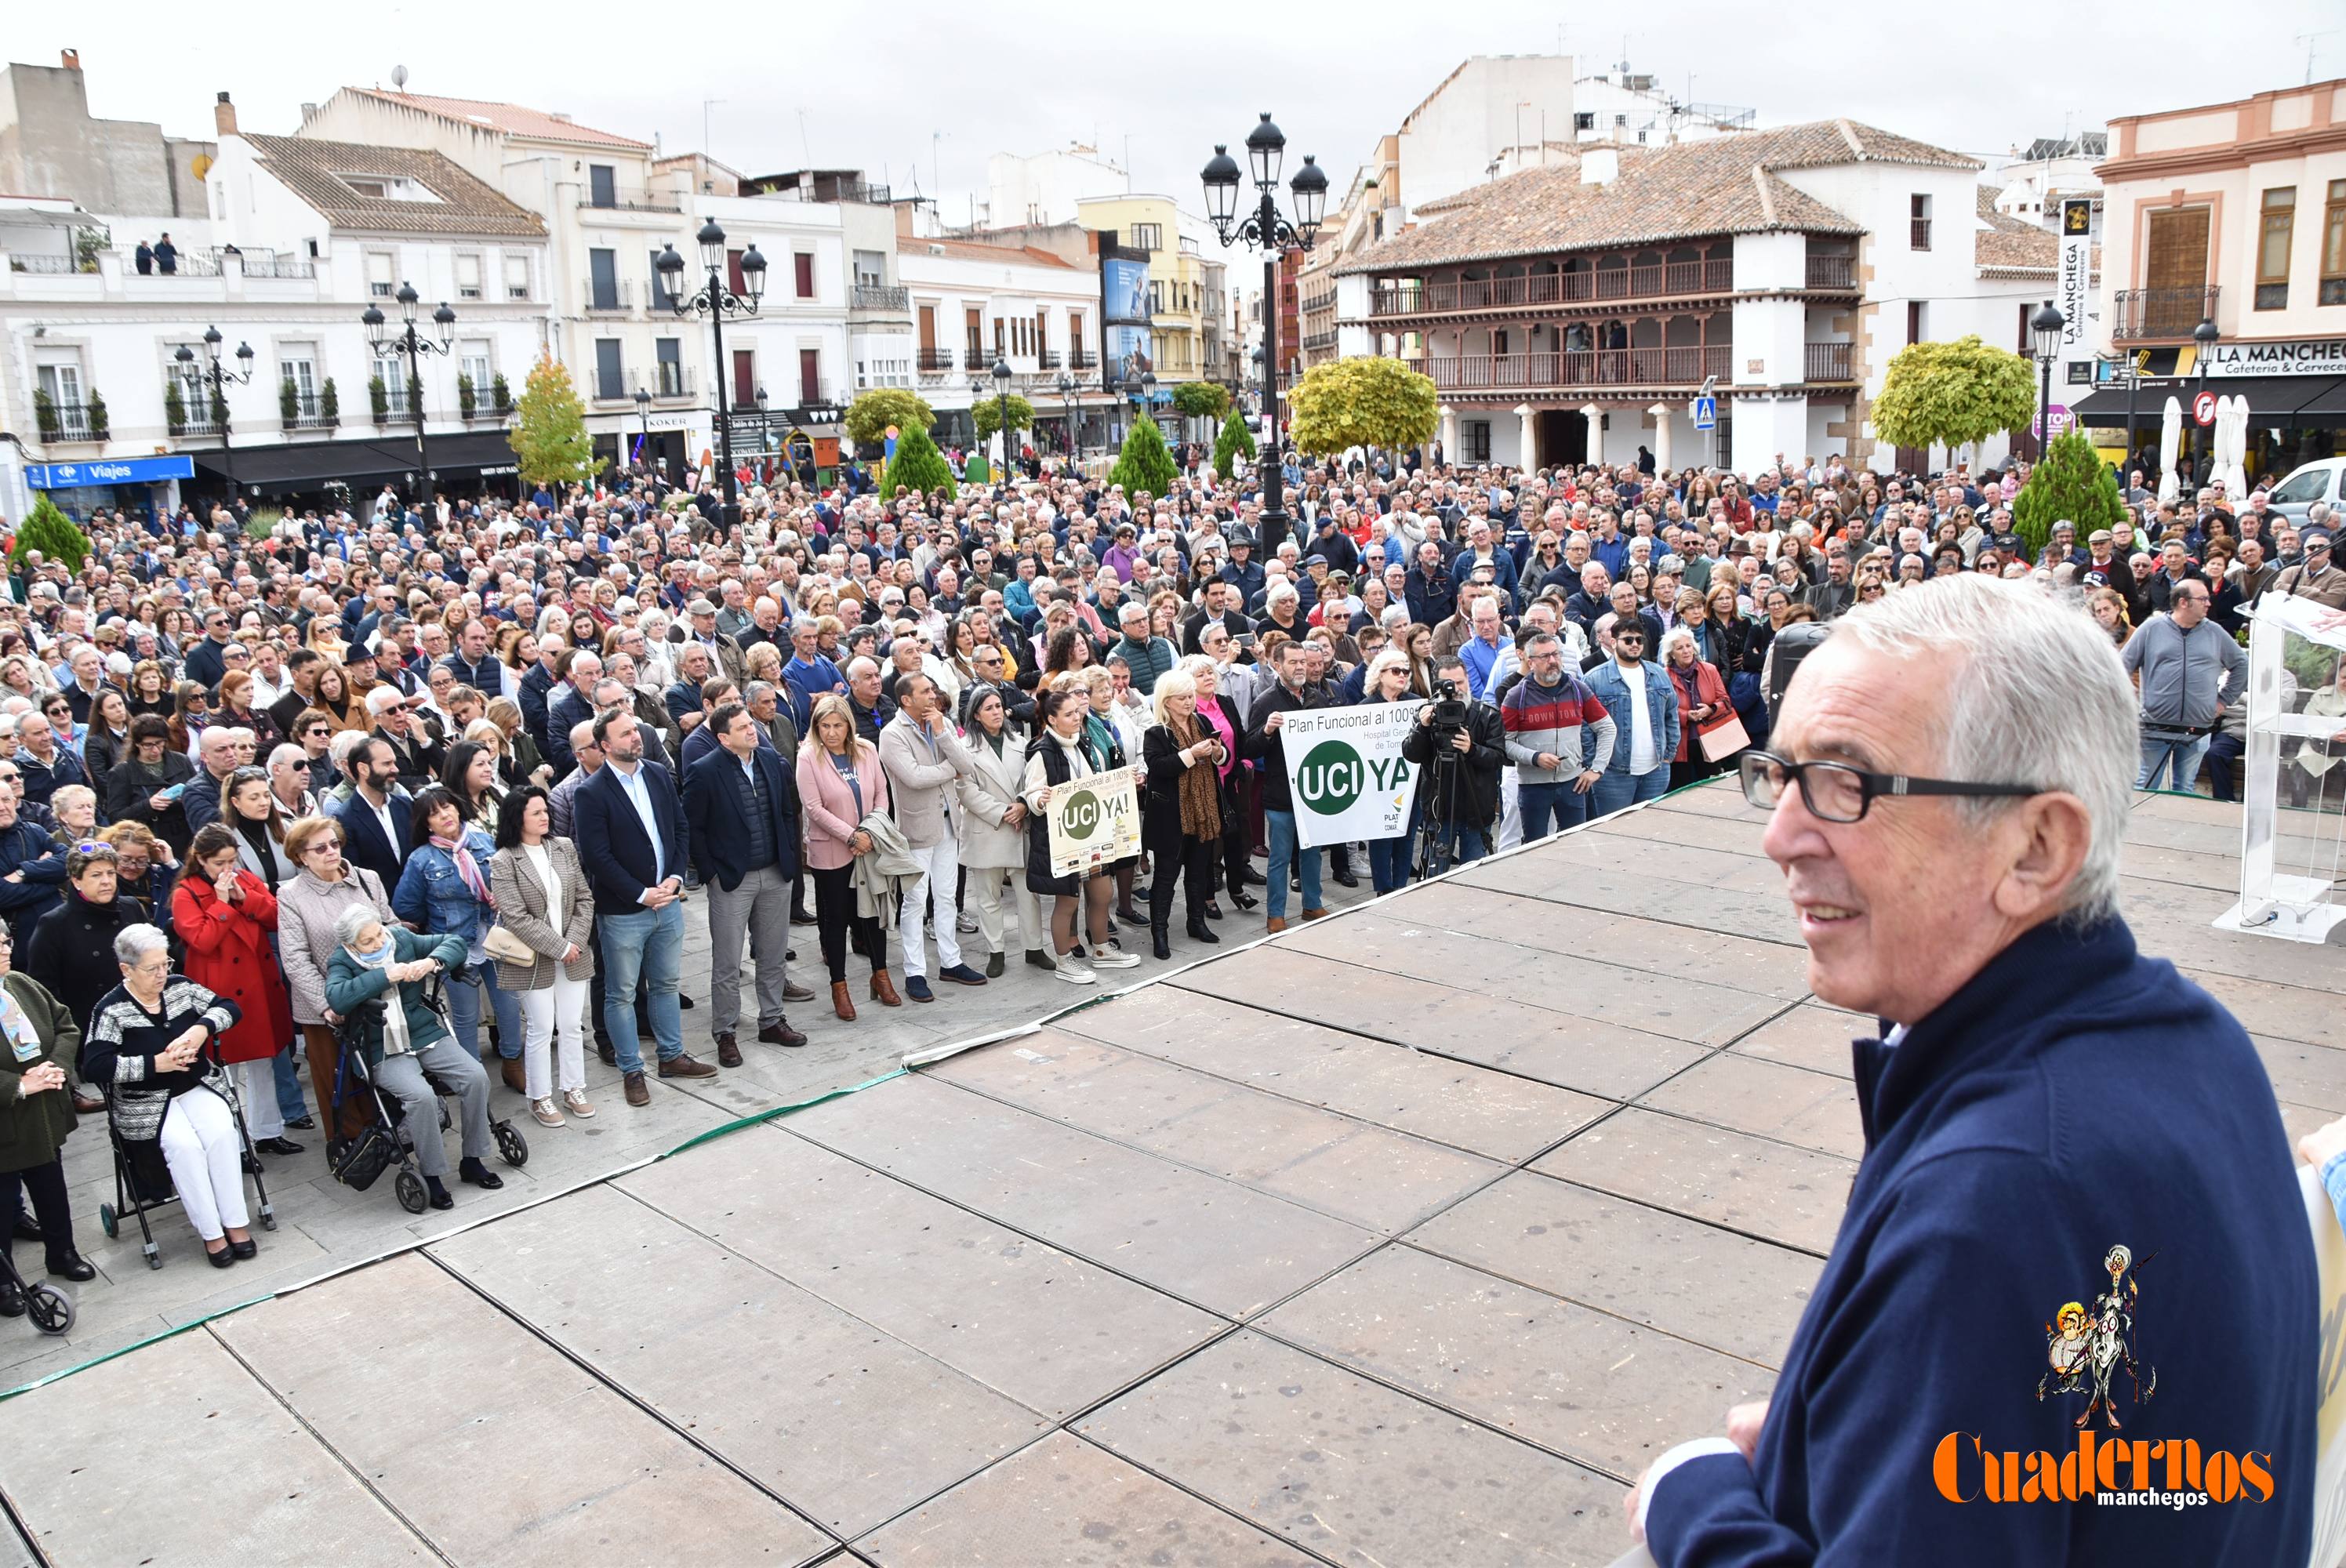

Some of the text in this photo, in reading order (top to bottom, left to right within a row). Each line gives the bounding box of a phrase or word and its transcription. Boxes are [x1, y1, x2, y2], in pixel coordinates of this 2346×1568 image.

[2065, 244, 2078, 344] LA MANCHEGA
[2217, 347, 2241, 362] LA
[2282, 361, 2291, 372] &
[648, 418, 687, 427] KOKER
[89, 465, 132, 480] Viajes
[1288, 719, 1313, 734] Plan
[1317, 711, 1371, 731] Funcional
[1375, 710, 1385, 728] al
[1528, 710, 1555, 724] DOWN
[1364, 728, 1391, 740] Hospital
[1375, 741, 1384, 750] de
[1057, 786, 1072, 796] Plan
[1073, 775, 1104, 792] Funcional
[1105, 775, 1111, 783] al
[1113, 770, 1129, 781] 100%
[1102, 793, 1129, 819] YA!
